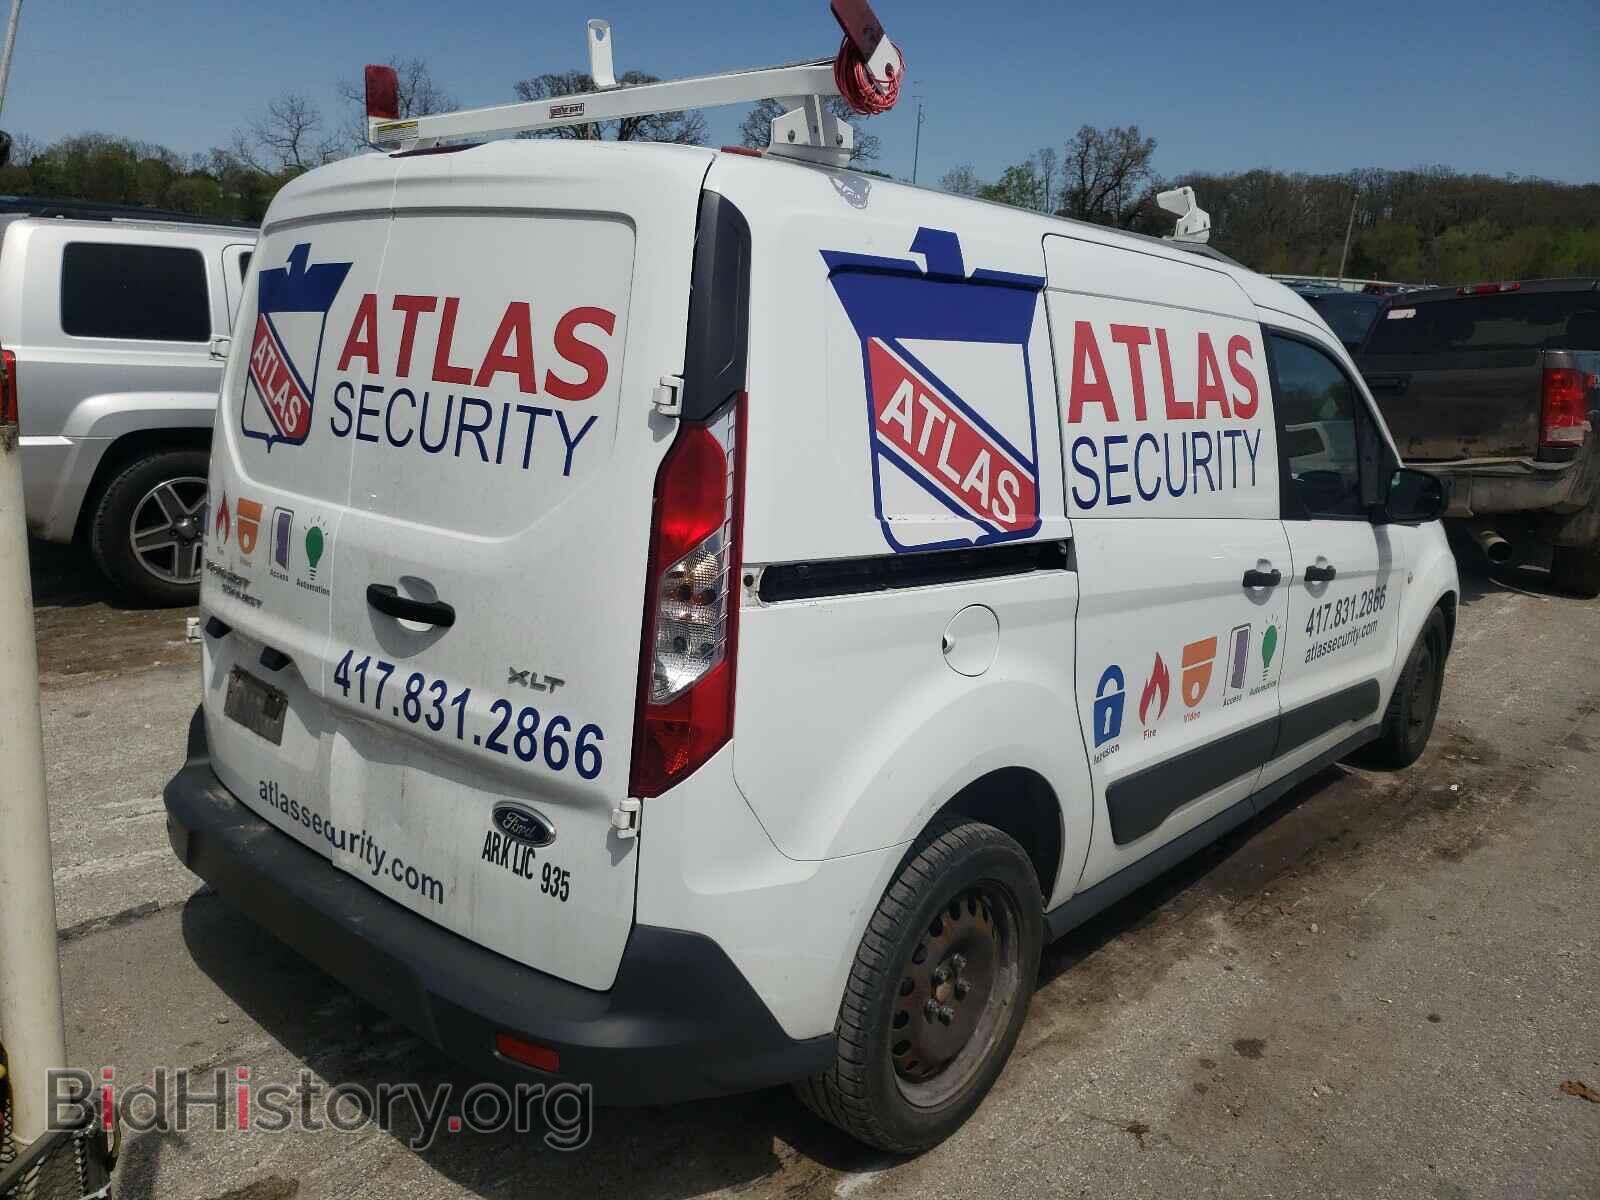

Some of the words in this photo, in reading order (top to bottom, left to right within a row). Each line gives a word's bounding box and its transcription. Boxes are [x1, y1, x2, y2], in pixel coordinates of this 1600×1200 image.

[253, 335, 301, 432] ATLAS
[337, 293, 616, 401] ATLAS
[1067, 320, 1259, 424] ATLAS
[330, 381, 598, 477] SECURITY
[879, 378, 1020, 524] ATLAS
[1071, 428, 1262, 510] SECURITY
[296, 577, 331, 597] Automation
[1305, 584, 1387, 637] 417.831.2866
[507, 666, 565, 694] XLT
[1305, 619, 1378, 664] atlassecurity.com
[334, 649, 605, 779] 417.831.2866
[1143, 728, 1158, 741] Fire
[259, 780, 444, 904] atlassecurity.com
[482, 830, 513, 869] ARK
[512, 842, 536, 880] LIC
[541, 862, 571, 902] 935
[502, 811, 539, 840] Ford
